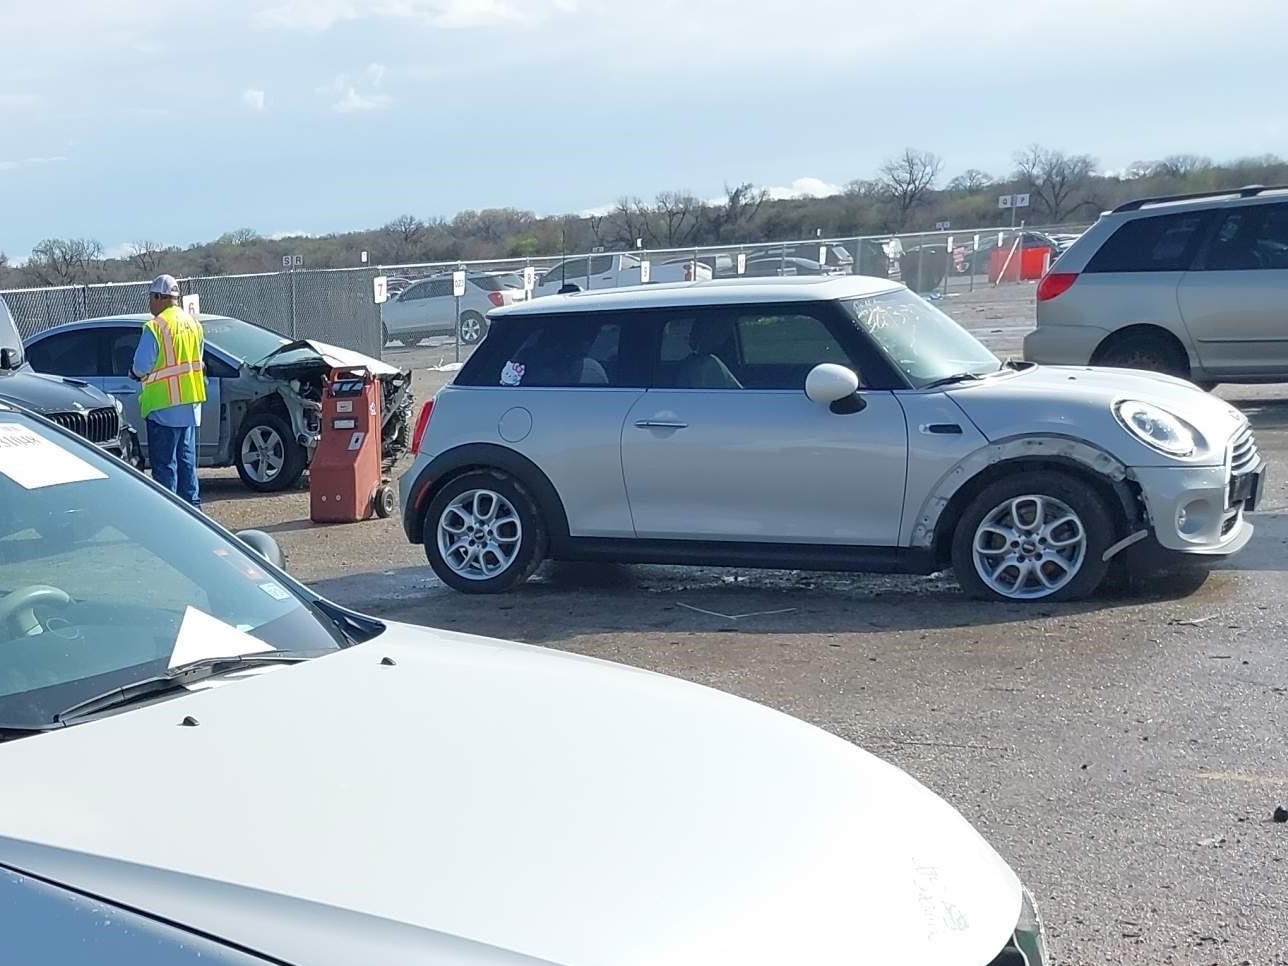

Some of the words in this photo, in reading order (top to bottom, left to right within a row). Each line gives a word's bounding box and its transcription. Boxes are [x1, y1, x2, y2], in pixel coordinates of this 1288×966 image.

[283, 256, 290, 265] S
[377, 283, 383, 297] 7
[188, 302, 196, 316] 6
